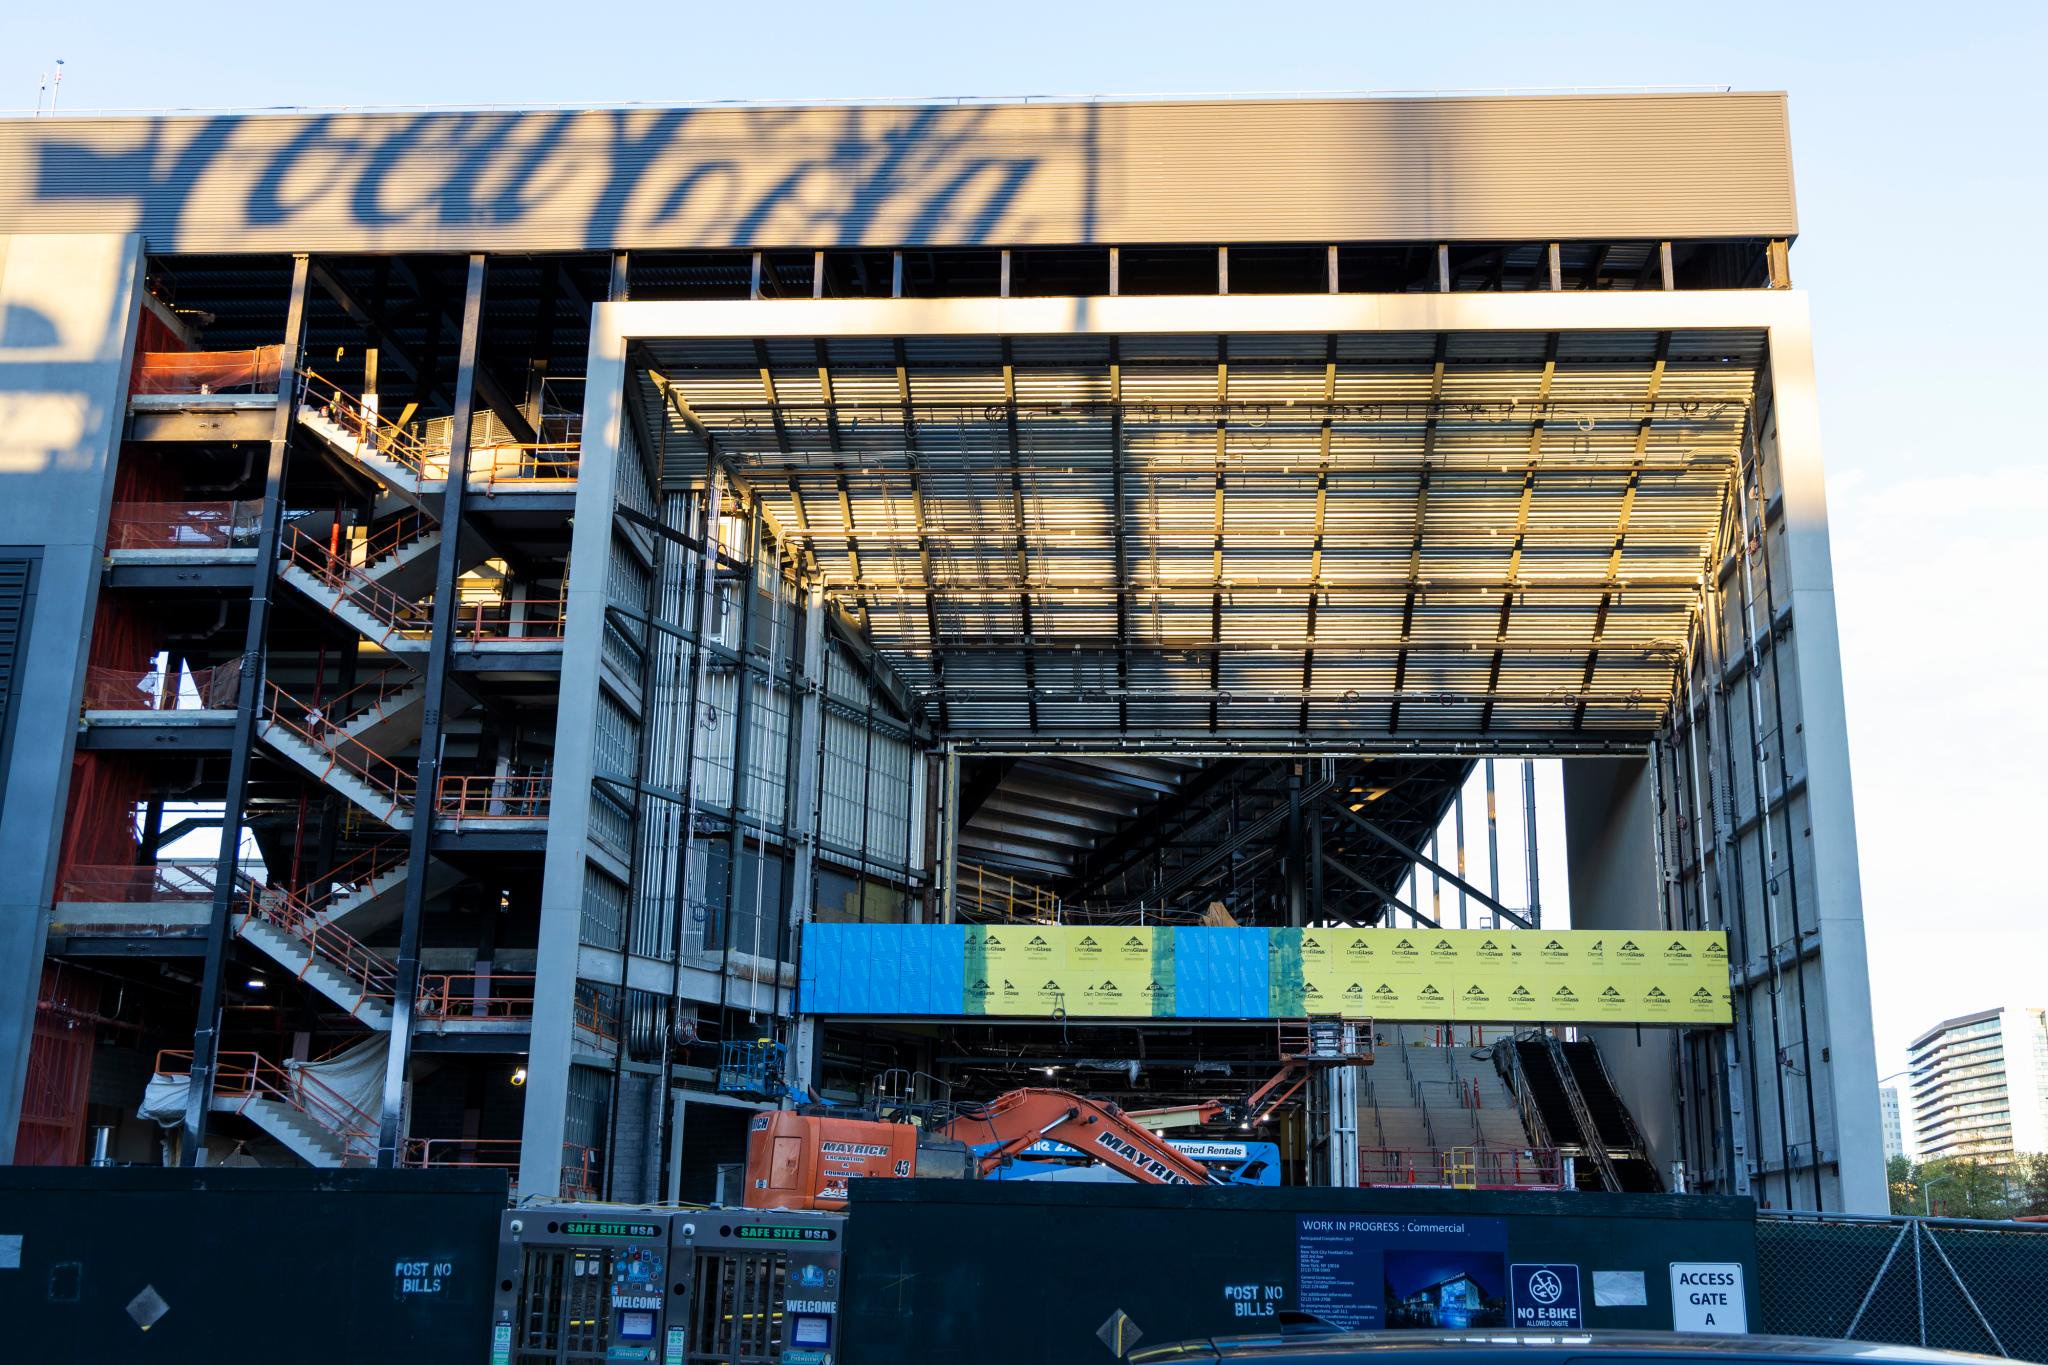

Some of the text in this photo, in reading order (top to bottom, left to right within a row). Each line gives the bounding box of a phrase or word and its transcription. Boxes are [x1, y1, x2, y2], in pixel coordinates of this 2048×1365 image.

[822, 1142, 888, 1156] MAYRICH
[1207, 1146, 1242, 1155] Rentals
[1096, 1131, 1191, 1184] MAYRIC
[894, 1160, 910, 1176] 43
[568, 1224, 654, 1235] SAFE SITE USA
[1303, 1220, 1333, 1230] WORK
[1336, 1221, 1346, 1230] IN
[1349, 1222, 1399, 1232] PROGRESS
[1407, 1223, 1464, 1232] Commercial
[741, 1228, 829, 1239] SAFE SITE USA
[396, 1262, 451, 1276] POST NO
[403, 1279, 440, 1292] BILLS
[1680, 1273, 1734, 1285] ACCESS
[1225, 1286, 1282, 1300] POST NO
[1690, 1293, 1727, 1305] GATE
[612, 1296, 662, 1309] WELCOME
[786, 1300, 836, 1313] WELCOME
[1235, 1302, 1274, 1316] BILLS
[1518, 1308, 1576, 1318] NO E-BIKE
[1706, 1313, 1715, 1325] A
